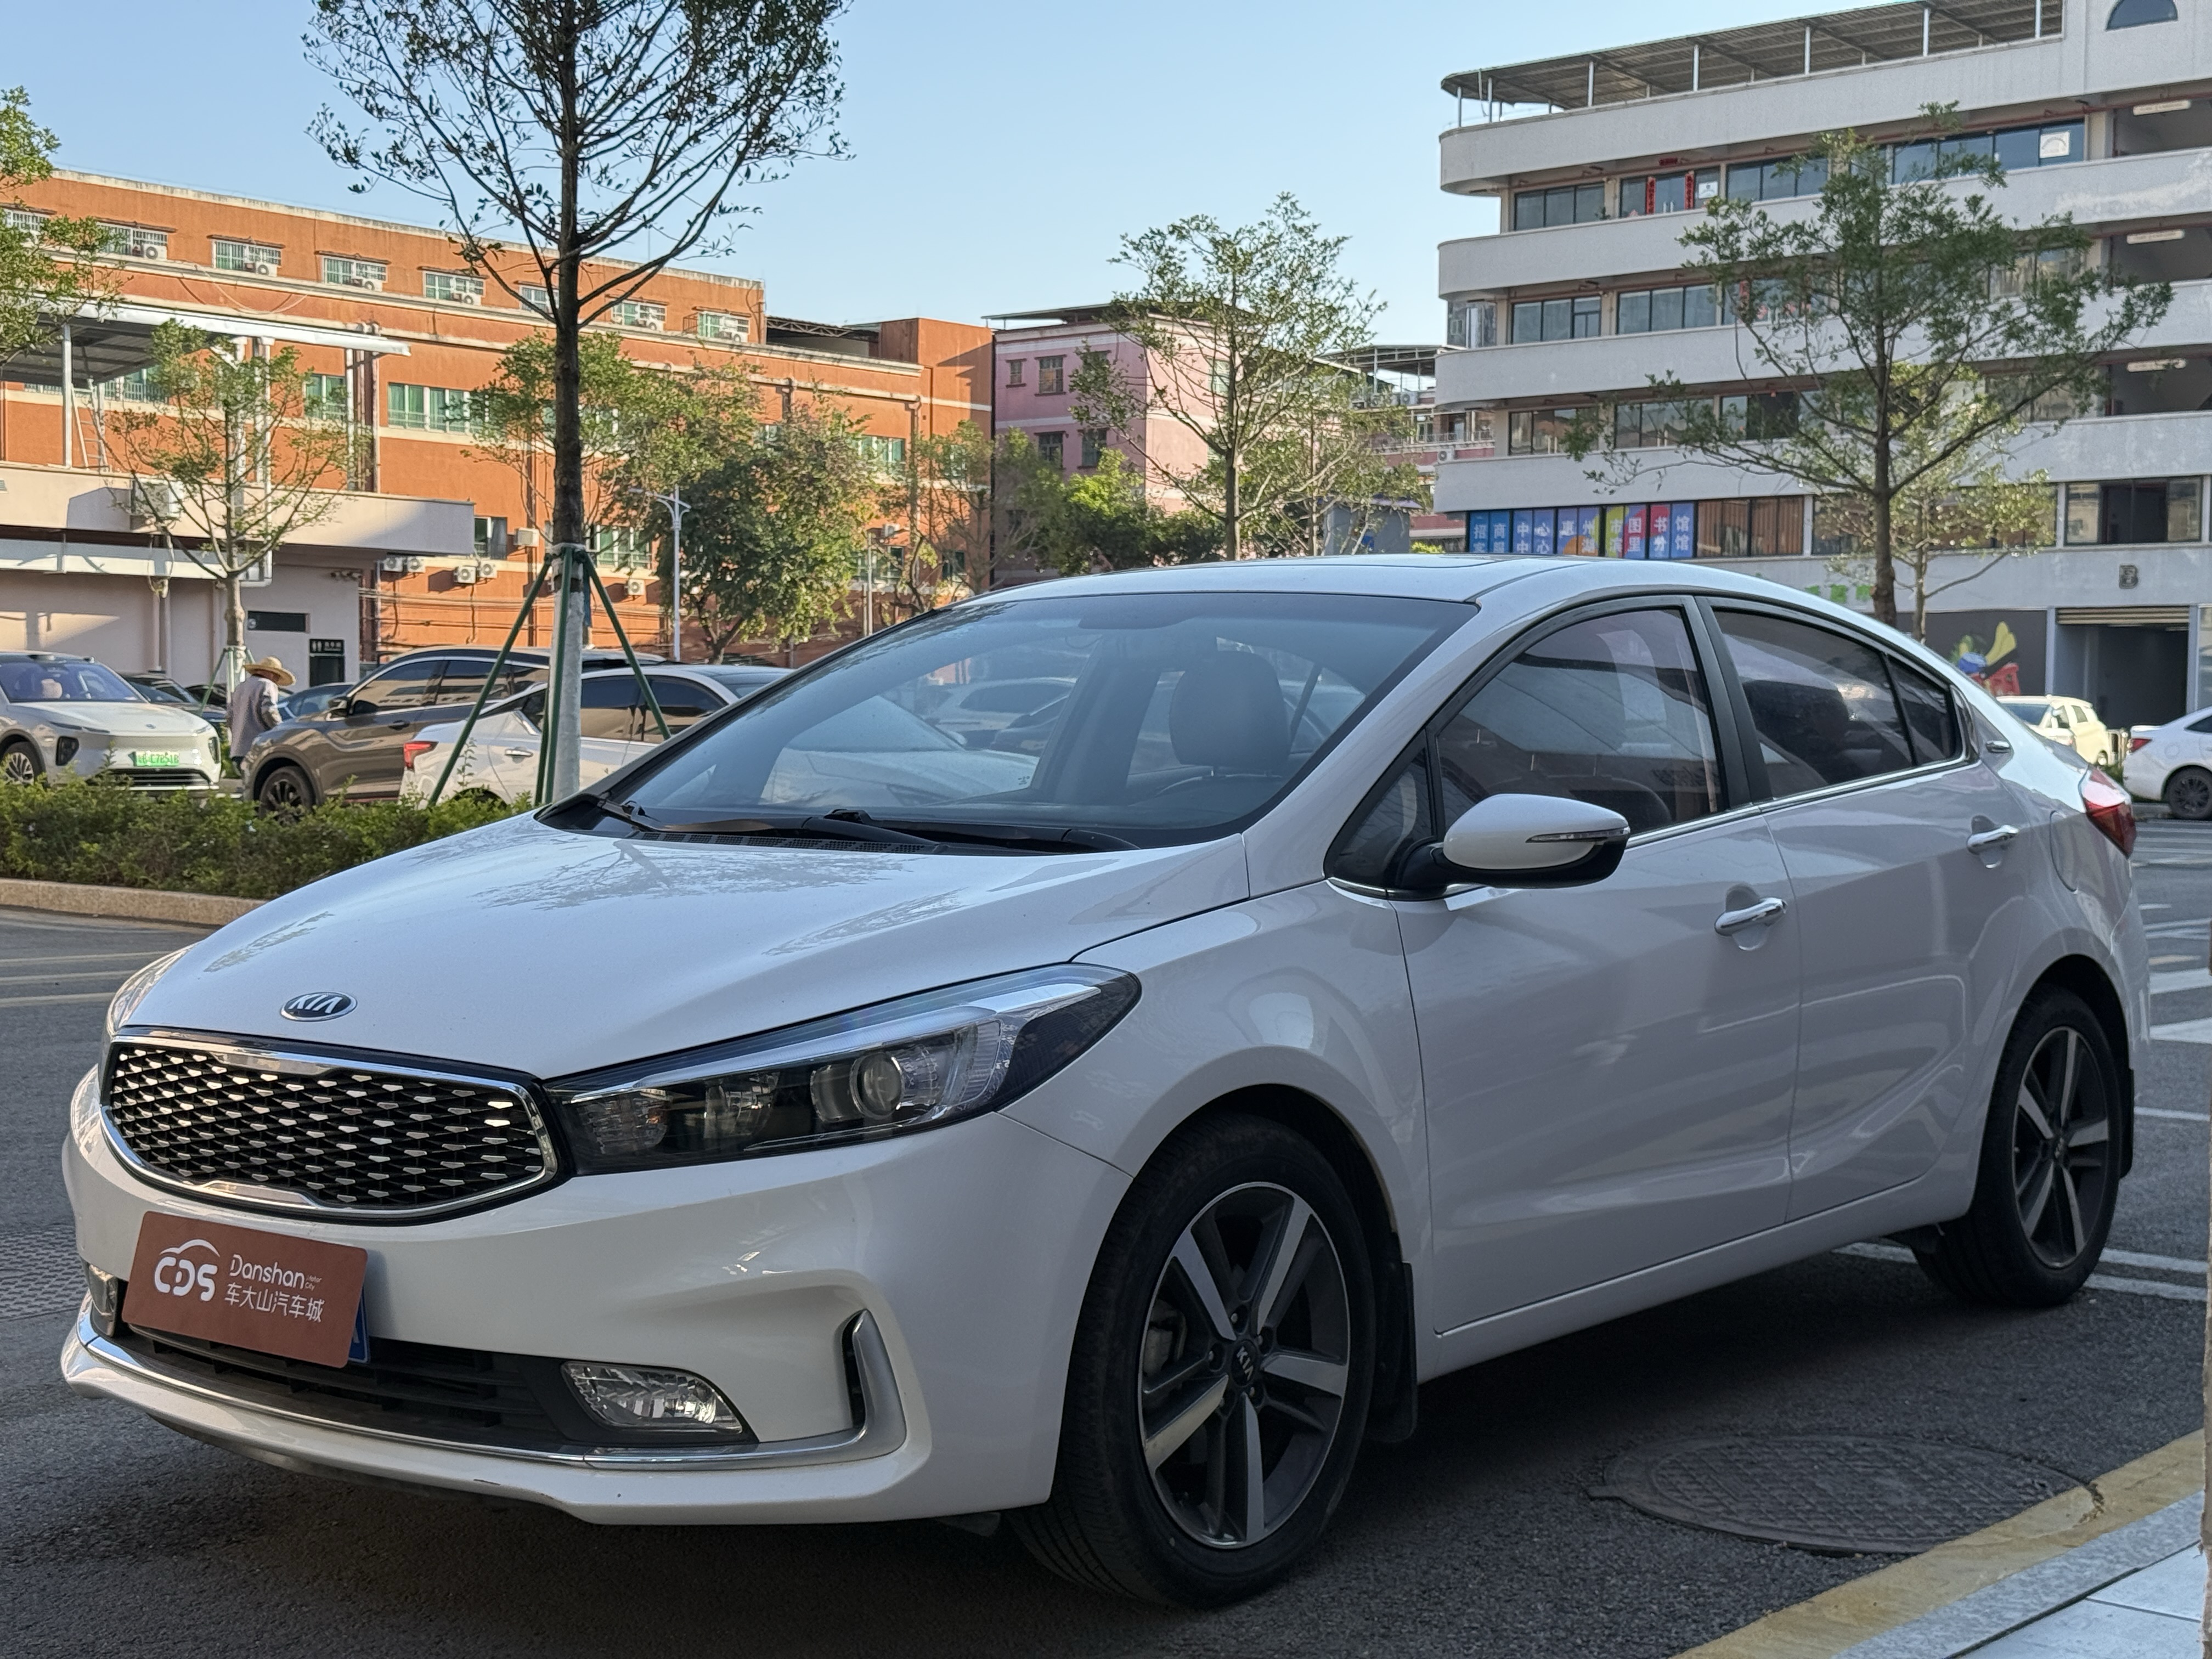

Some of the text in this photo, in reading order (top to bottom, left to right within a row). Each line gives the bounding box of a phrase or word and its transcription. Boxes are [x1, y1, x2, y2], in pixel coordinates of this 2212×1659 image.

[1474, 522, 1551, 540] 招商中心
[1559, 515, 1690, 537] 惠州市图书馆
[287, 993, 343, 1014] KIA
[229, 1254, 305, 1290] Danshan
[304, 1282, 316, 1291] City
[224, 1282, 325, 1323] 车大山汽车城
[1236, 1346, 1254, 1381] KIA
